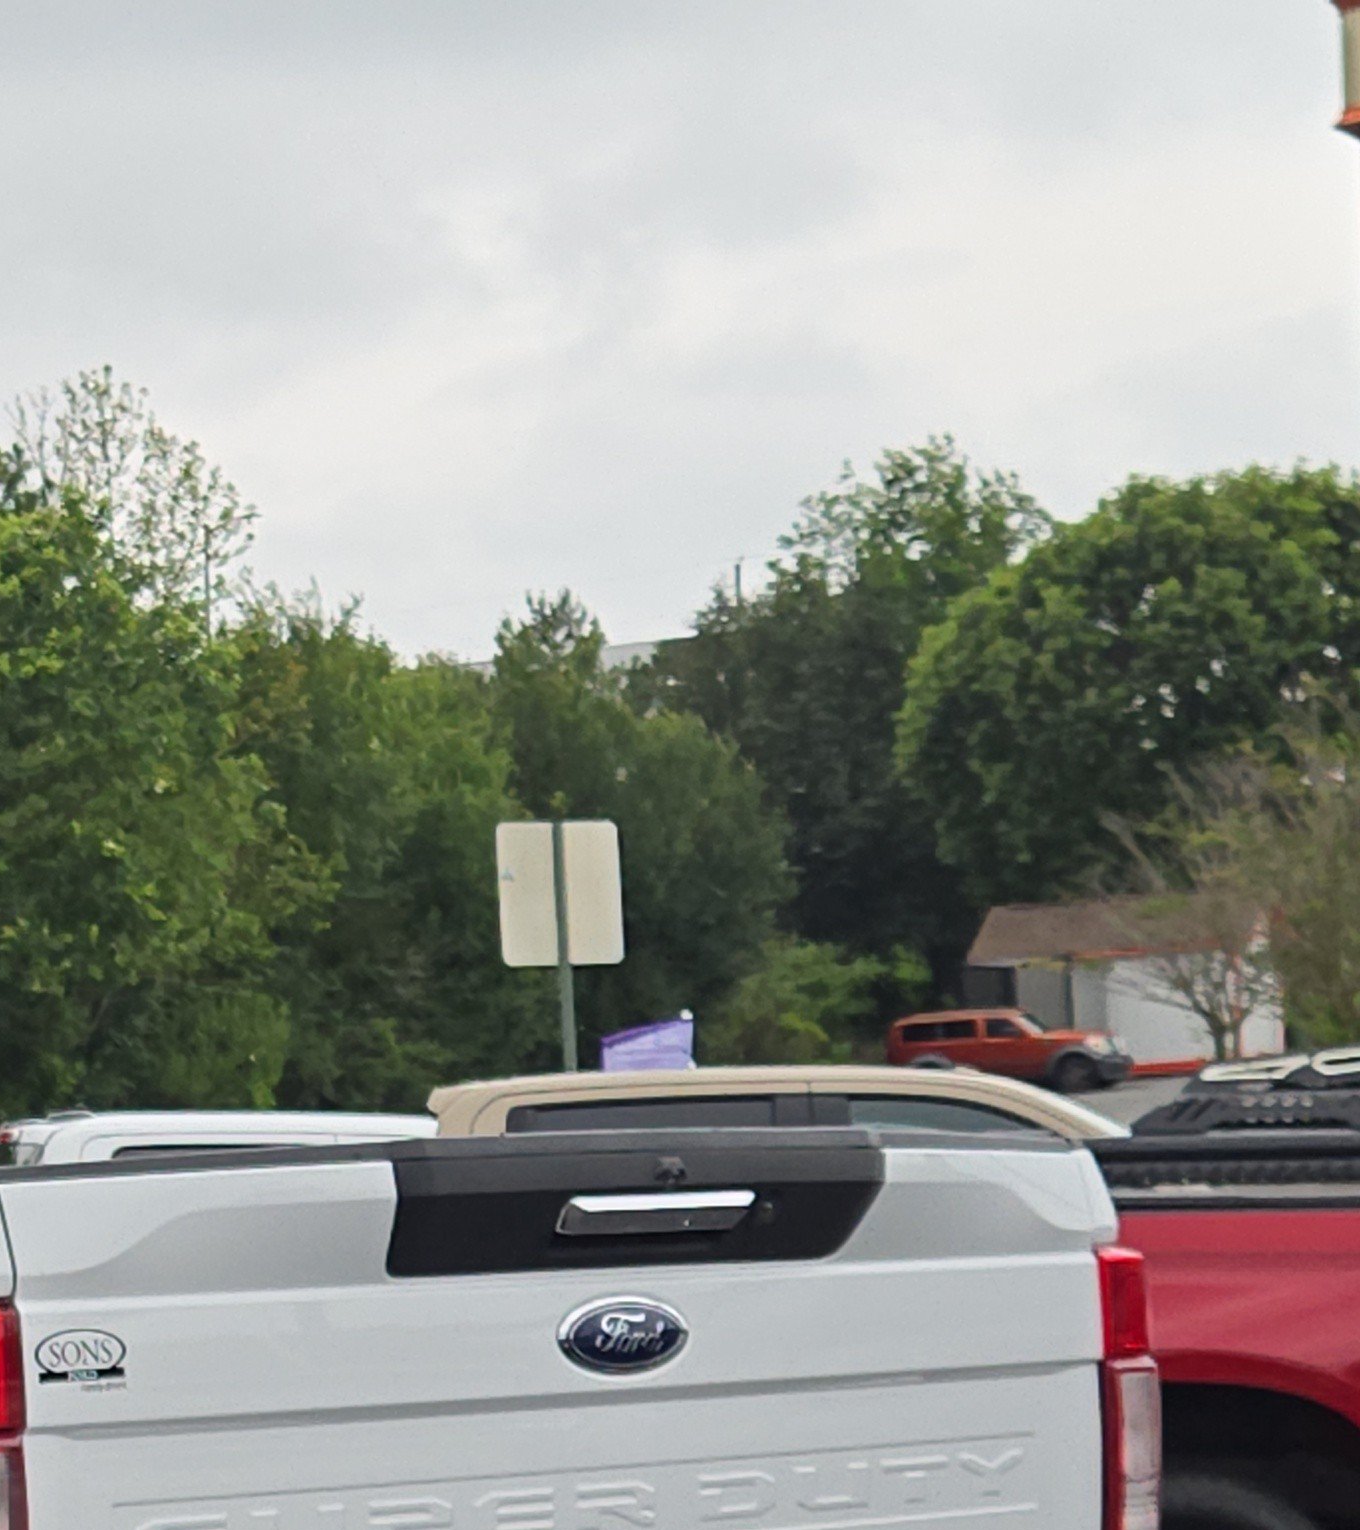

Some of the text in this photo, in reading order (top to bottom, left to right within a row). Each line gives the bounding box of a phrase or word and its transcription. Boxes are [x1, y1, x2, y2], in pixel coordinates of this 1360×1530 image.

[47, 1338, 114, 1368] SONS
[594, 1312, 666, 1353] Ford
[696, 1447, 1025, 1522] DUTY
